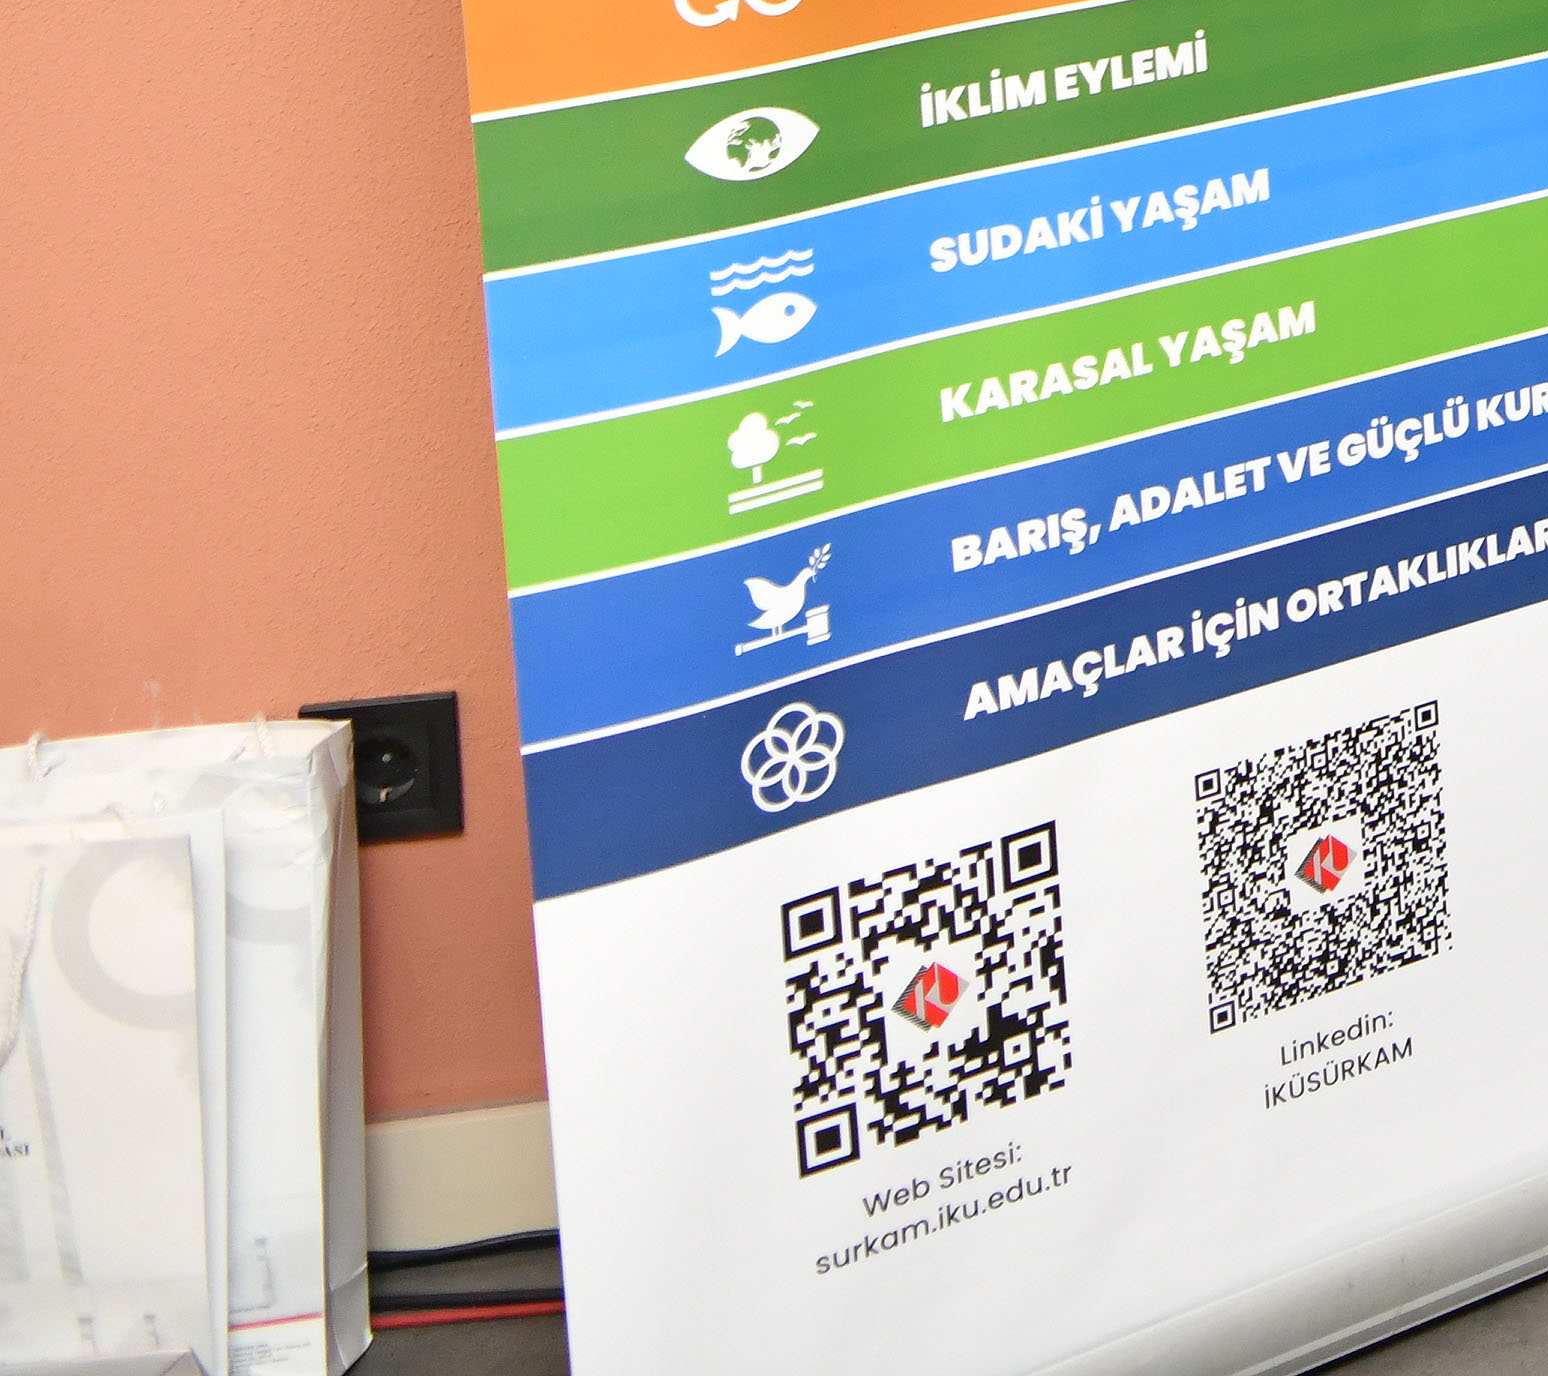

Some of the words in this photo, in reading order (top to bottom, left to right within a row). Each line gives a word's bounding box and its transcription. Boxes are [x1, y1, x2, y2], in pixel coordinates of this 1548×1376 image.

[920, 68, 1047, 128] İKLİM
[1054, 29, 1208, 102] EYLEMİ
[929, 195, 1104, 273] SUDAKİ
[1109, 167, 1270, 233] YAŞAM
[940, 343, 1154, 423] KARASAL
[1158, 300, 1316, 368] YAŞAM
[951, 507, 1102, 573] BARIŞ,
[1108, 455, 1272, 532] ADALET
[1276, 440, 1331, 483] VE
[1336, 395, 1470, 467] GÜÇLÜ
[963, 626, 1185, 721] AMAÇLAR
[1191, 596, 1280, 659] İÇİN
[1265, 1037, 1413, 1109] İKÜSÜRKAM
[1280, 1011, 1397, 1066] Linkedin:
[816, 1165, 1072, 1275] surkam.iku.edu.tr
[862, 1178, 930, 1217] Web
[939, 1141, 1022, 1189] Sitesi:
